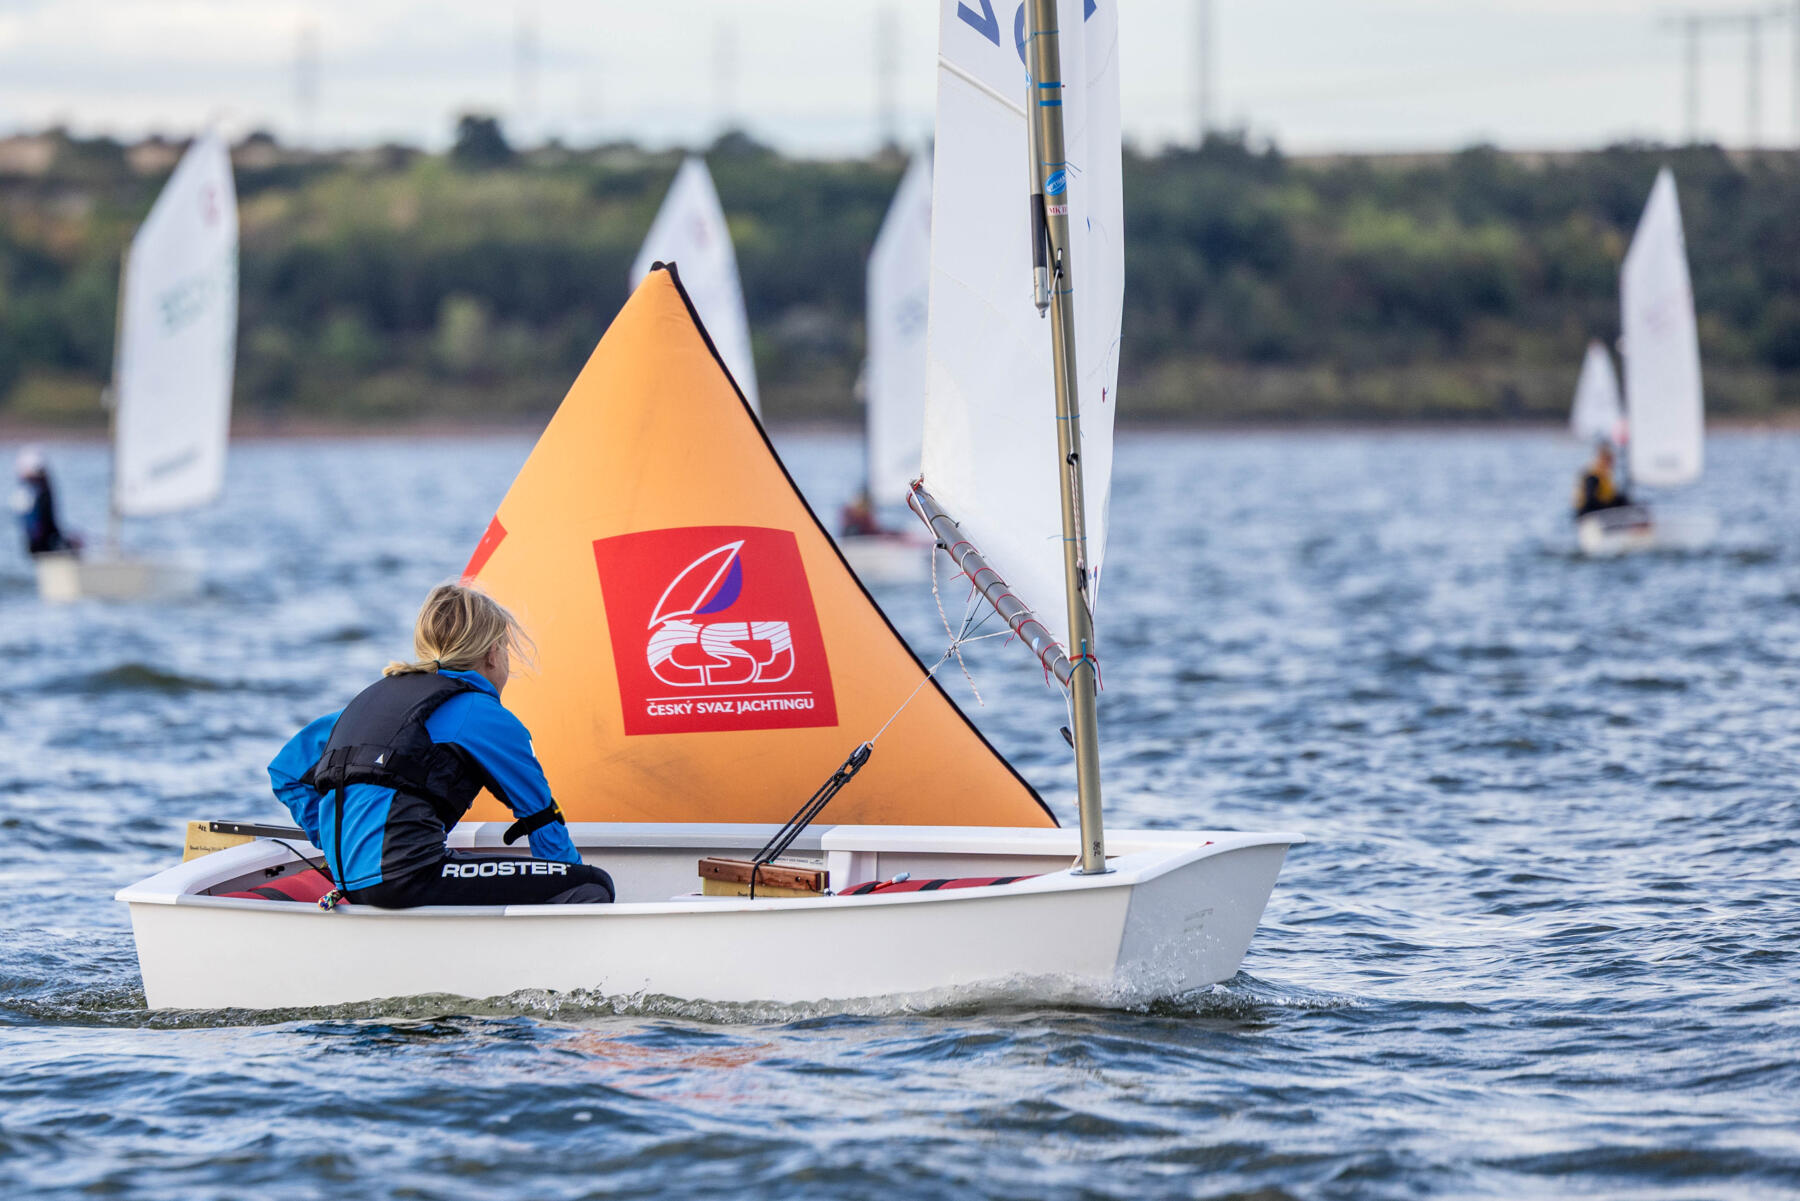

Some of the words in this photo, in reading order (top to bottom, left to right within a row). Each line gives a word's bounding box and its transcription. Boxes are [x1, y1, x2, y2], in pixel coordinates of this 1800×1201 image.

[647, 701, 693, 716] ČESKÝ
[697, 701, 734, 714] SVAZ
[737, 698, 815, 715] JACHTINGU
[441, 861, 568, 878] ROOSTER
